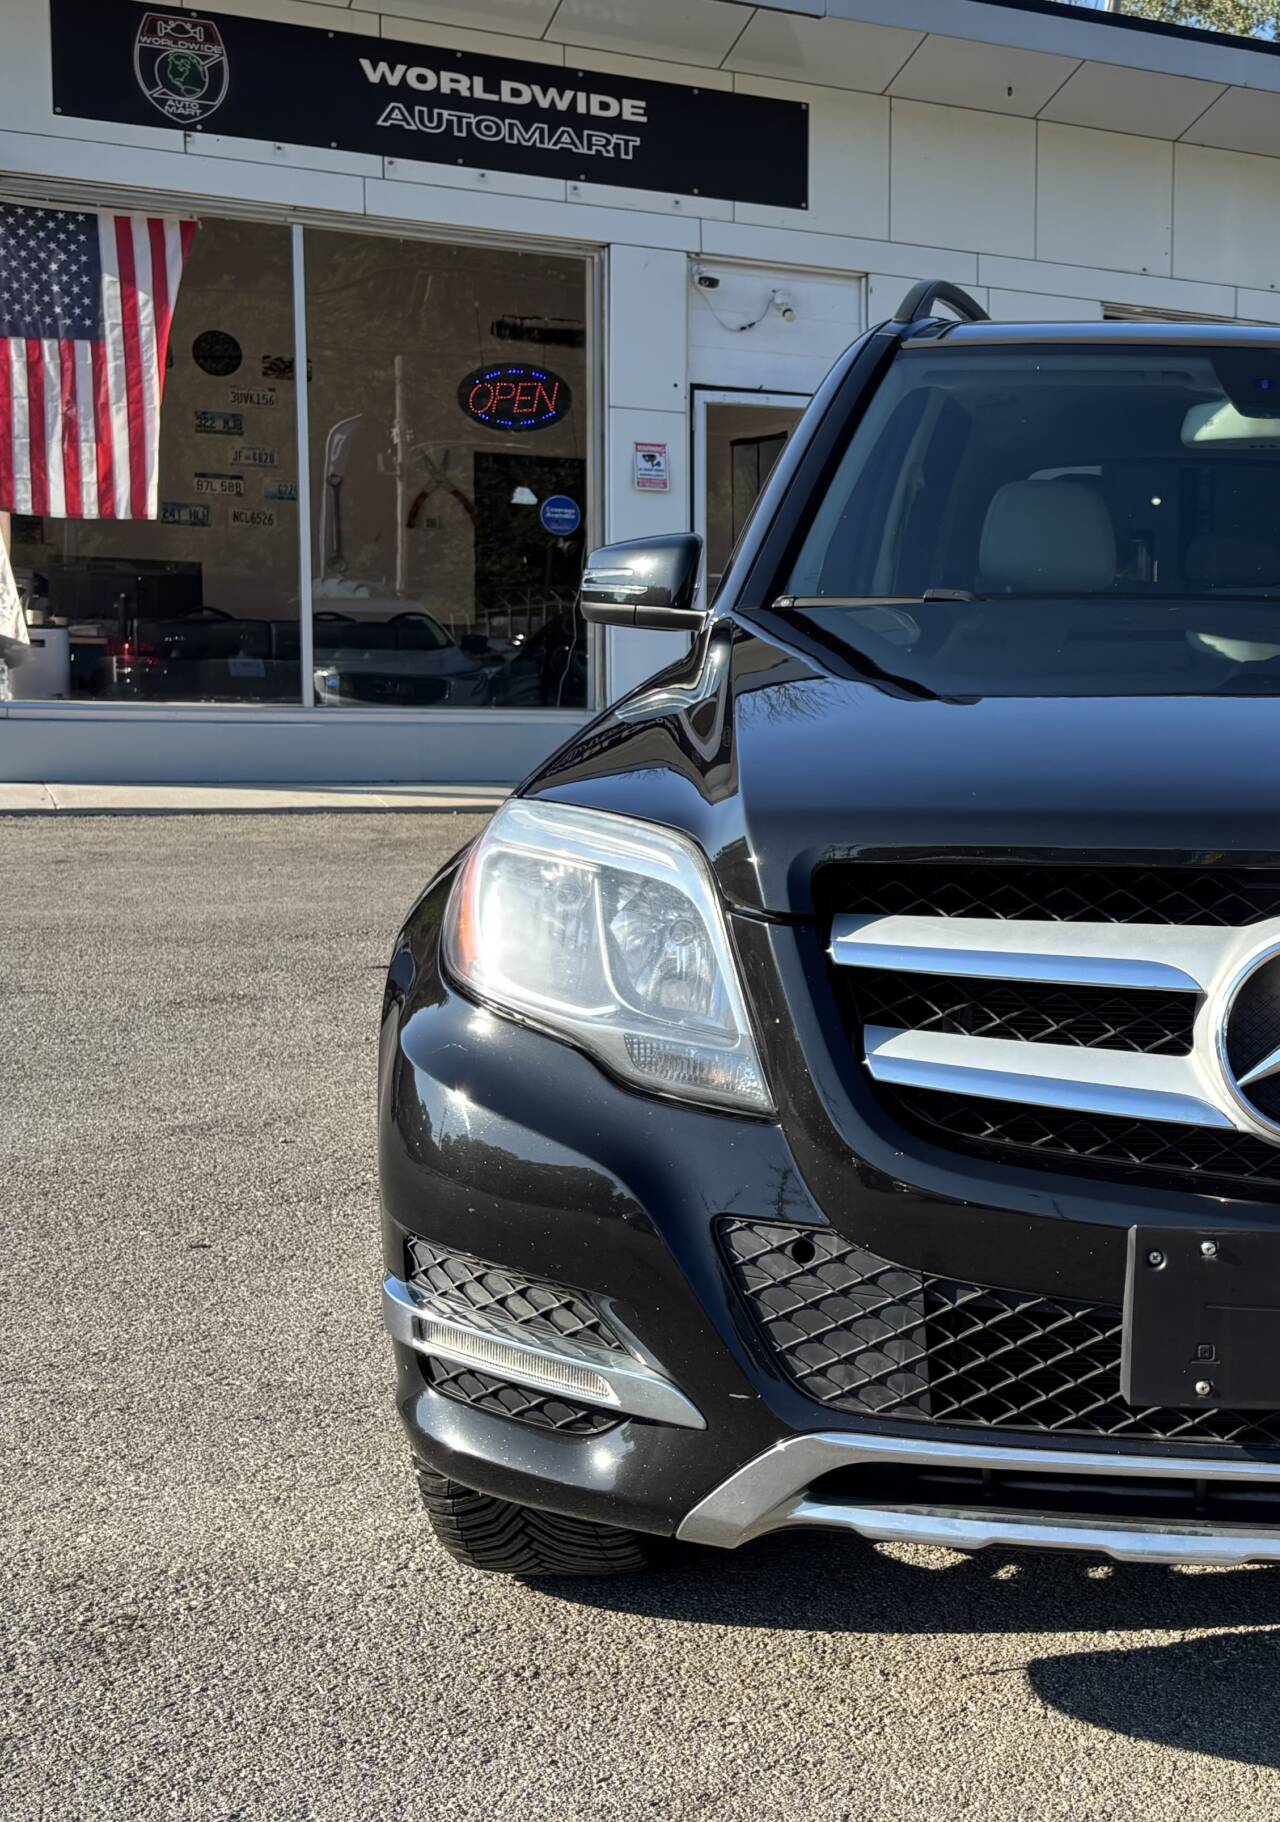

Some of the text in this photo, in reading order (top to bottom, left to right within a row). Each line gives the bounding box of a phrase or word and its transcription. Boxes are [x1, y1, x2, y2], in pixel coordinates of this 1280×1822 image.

[140, 36, 223, 53] WORLDWIDE
[358, 58, 648, 123] WORLDWIDE
[164, 106, 202, 116] MART
[166, 100, 199, 109] AUTO
[376, 102, 641, 160] AUTOMART
[469, 382, 560, 415] OPEN
[233, 510, 275, 526] NCL6526
